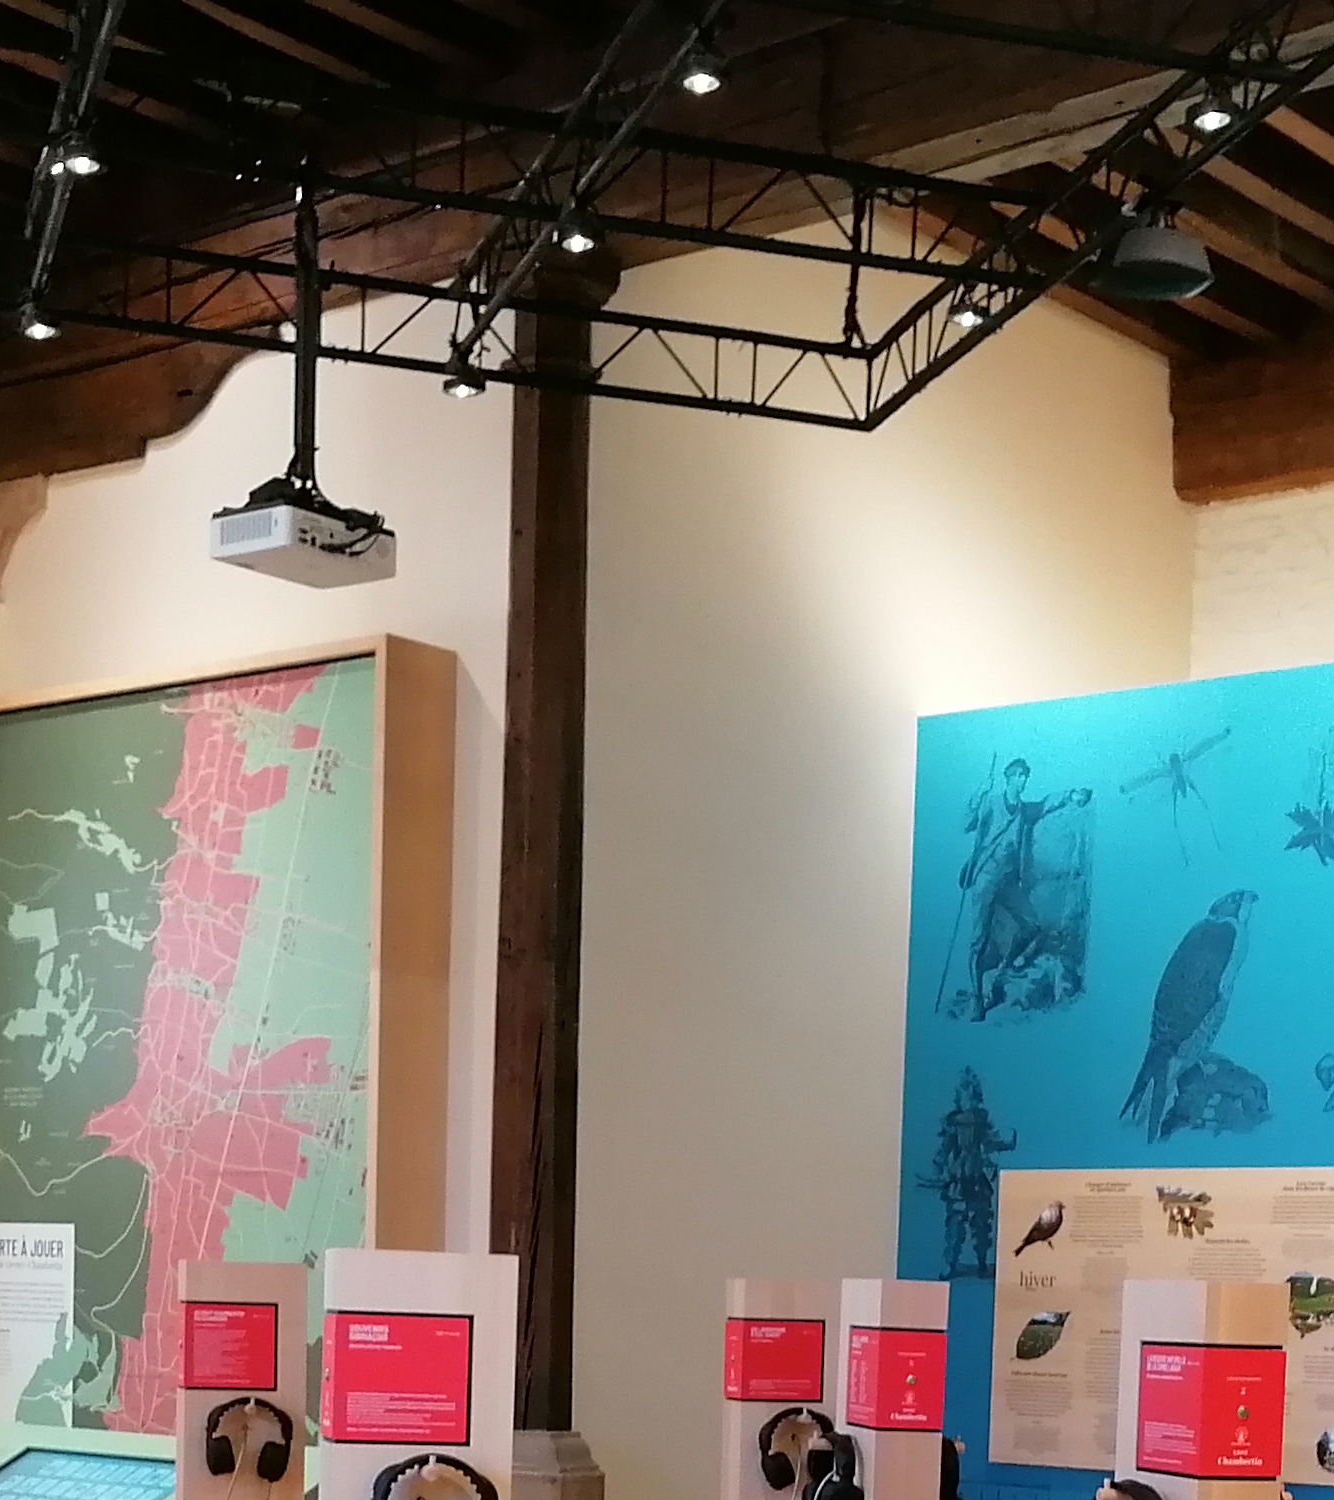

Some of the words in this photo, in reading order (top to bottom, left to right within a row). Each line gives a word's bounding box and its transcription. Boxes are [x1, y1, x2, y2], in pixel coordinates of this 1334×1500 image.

[20, 1234, 28, 1257] À
[30, 1239, 64, 1258] JOUER
[1019, 1270, 1057, 1288] hiver
[1217, 1455, 1263, 1466] Chambertin
